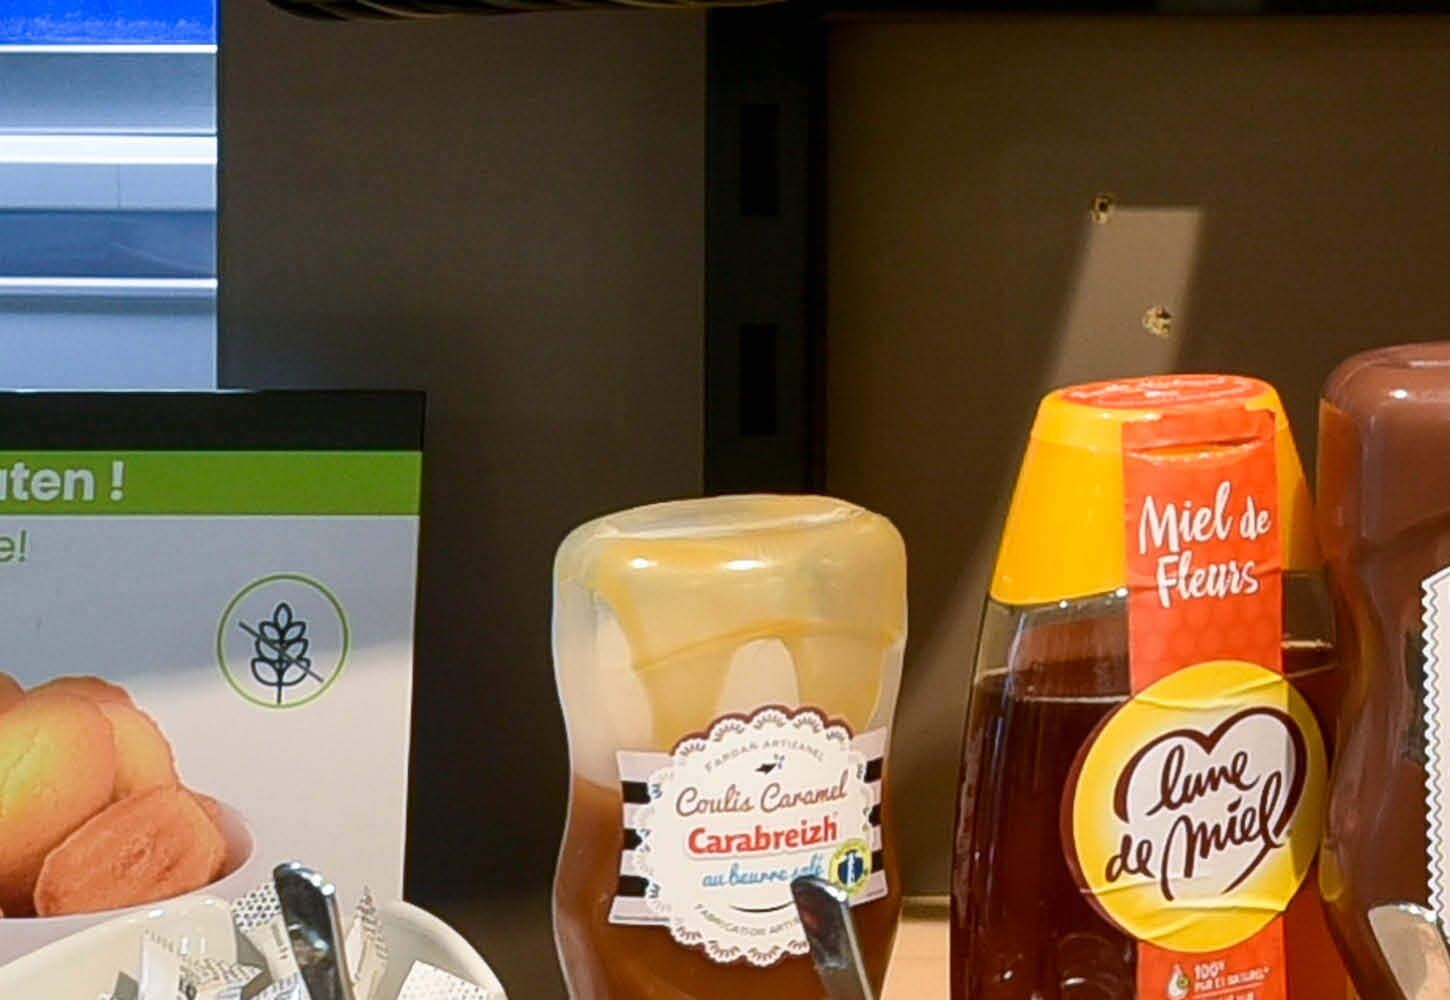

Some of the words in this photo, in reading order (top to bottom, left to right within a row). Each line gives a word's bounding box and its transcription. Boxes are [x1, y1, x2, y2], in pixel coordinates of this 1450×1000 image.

[0, 460, 95, 502] ten
[1138, 480, 1233, 555] Miel
[1239, 495, 1271, 540] de
[1156, 550, 1259, 609] Fleurs
[675, 783, 754, 818] Coulis
[759, 768, 849, 814] Caramel
[688, 815, 838, 855] Carabreizh
[1105, 834, 1155, 883] de
[702, 873, 724, 888] au
[729, 862, 788, 886] beurre
